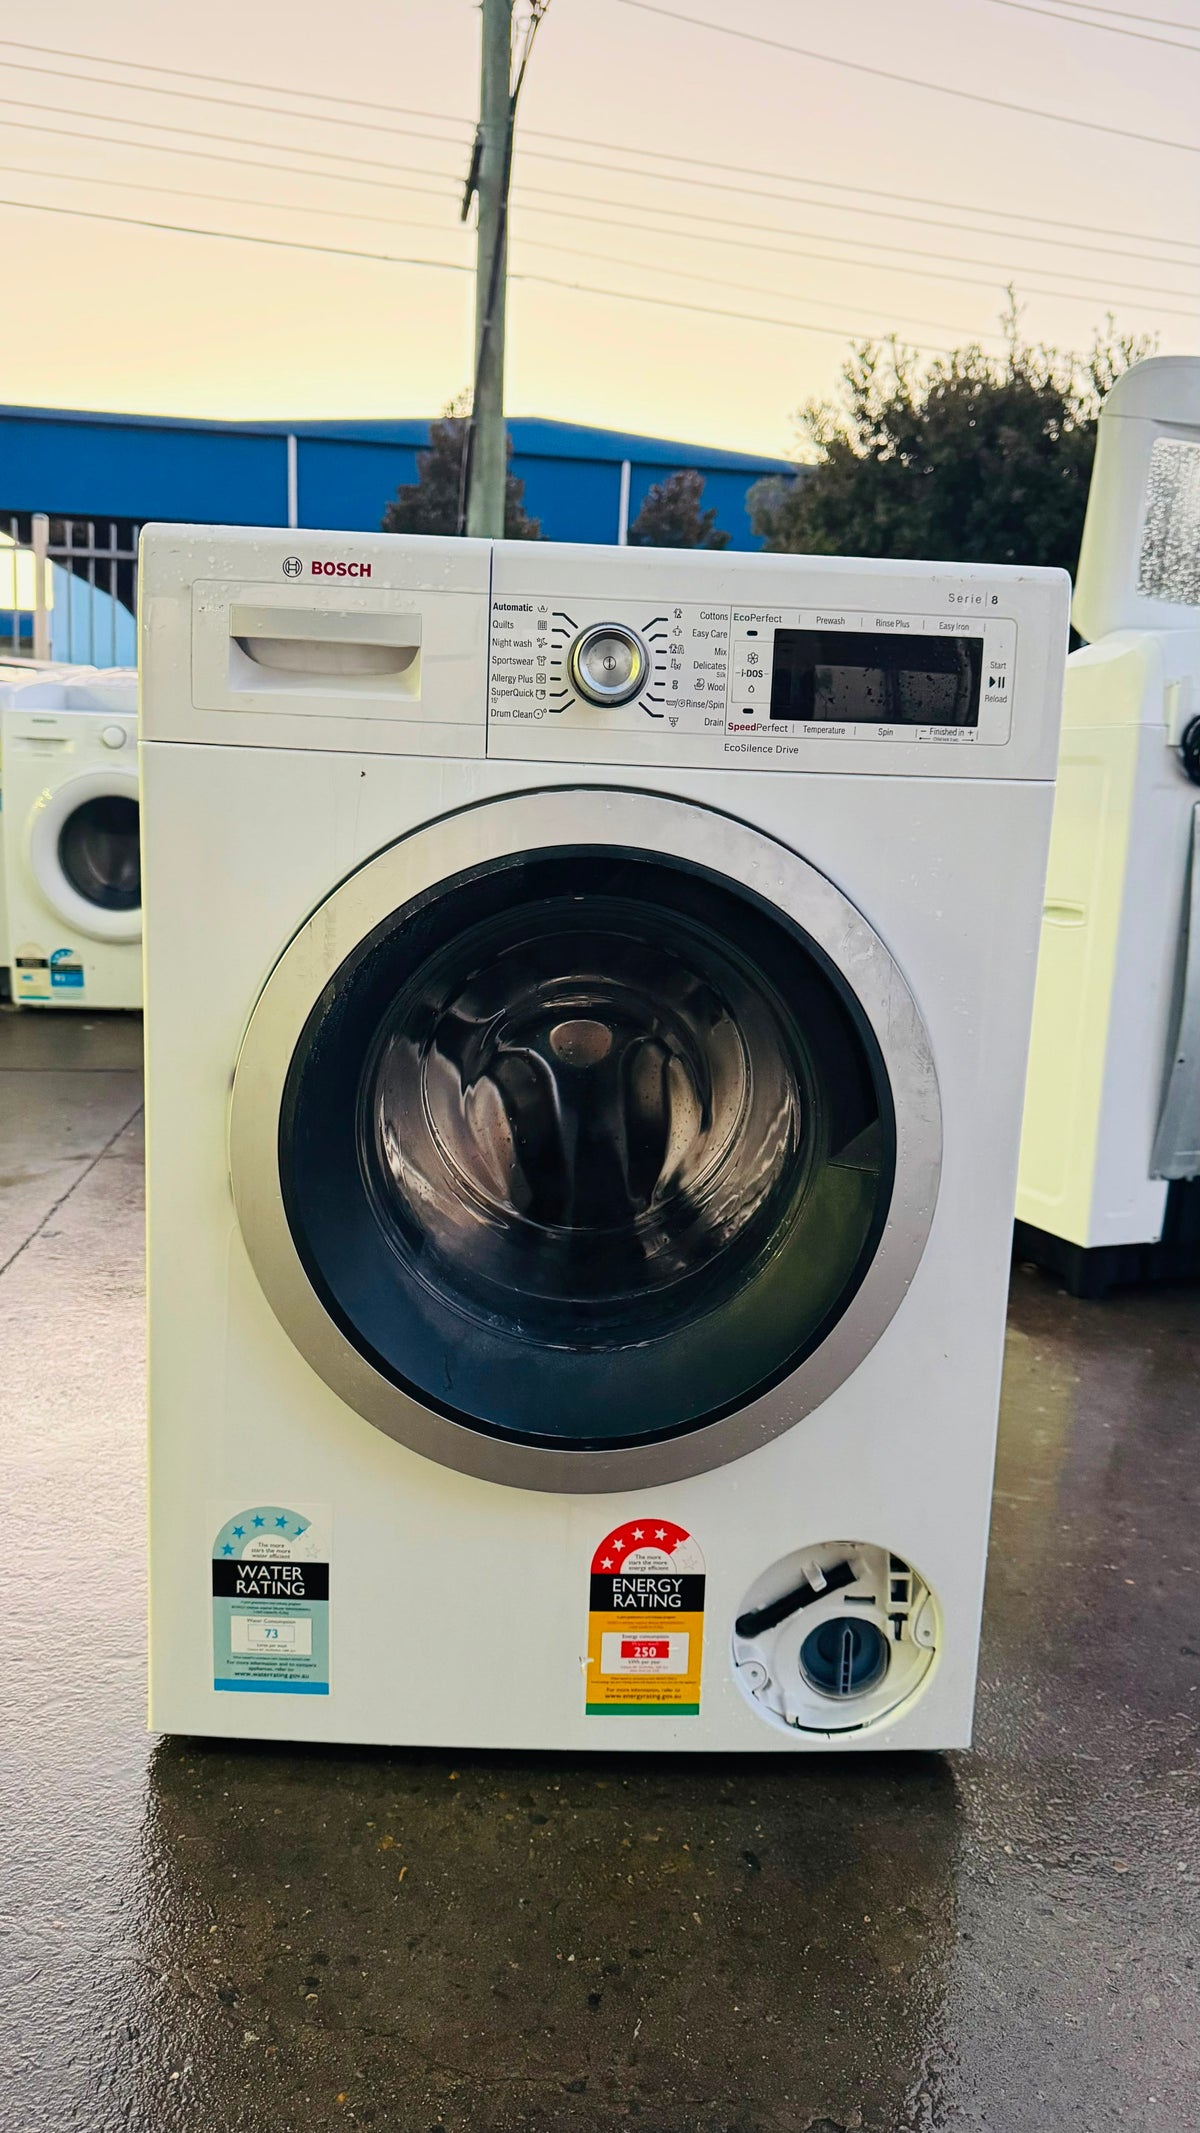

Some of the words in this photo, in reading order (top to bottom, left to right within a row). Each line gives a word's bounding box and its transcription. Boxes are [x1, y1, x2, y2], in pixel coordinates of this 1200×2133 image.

[311, 560, 372, 577] BOSCH
[948, 593, 982, 604] Serie
[991, 595, 998, 605] 8
[492, 602, 533, 612] Automatic
[700, 611, 728, 621] Cottons
[733, 613, 782, 623] EcoPerfect
[816, 616, 845, 625] Prewash
[492, 620, 514, 629] Quilts
[876, 619, 894, 628] Rinse
[895, 620, 910, 629] Plus
[939, 622, 955, 632] Easy
[956, 623, 970, 631] Iron
[692, 629, 710, 639] Easy
[711, 630, 728, 638] Care
[492, 638, 512, 649] Night
[513, 639, 532, 648] wash
[714, 648, 727, 656] Mix
[492, 656, 533, 666] Sportswear
[693, 661, 727, 670] Delicates
[990, 661, 1007, 670] Start
[741, 669, 763, 678] i-DOS
[491, 674, 517, 684] Allergy
[518, 675, 533, 684] Plus
[707, 683, 725, 691] Wool
[491, 688, 534, 698] SuperQuick
[984, 695, 1007, 703] Reload
[686, 700, 725, 709] Rinse/Spin
[490, 709, 511, 718] Drum
[512, 710, 533, 719] Clean
[704, 718, 724, 727] Drain
[728, 722, 788, 733] SpeedPerfect
[803, 725, 846, 735] Temperature
[878, 728, 894, 737] Spin
[929, 727, 957, 736] Finished
[958, 728, 965, 736] in
[724, 743, 773, 753] EcoSilence
[775, 745, 799, 754] Drive
[237, 1564, 303, 1581] WATER
[236, 1579, 305, 1596] RATING
[612, 1578, 683, 1593] ENERGY
[613, 1593, 682, 1608] RATING
[264, 1628, 278, 1639] 73
[634, 1646, 657, 1657] 250
